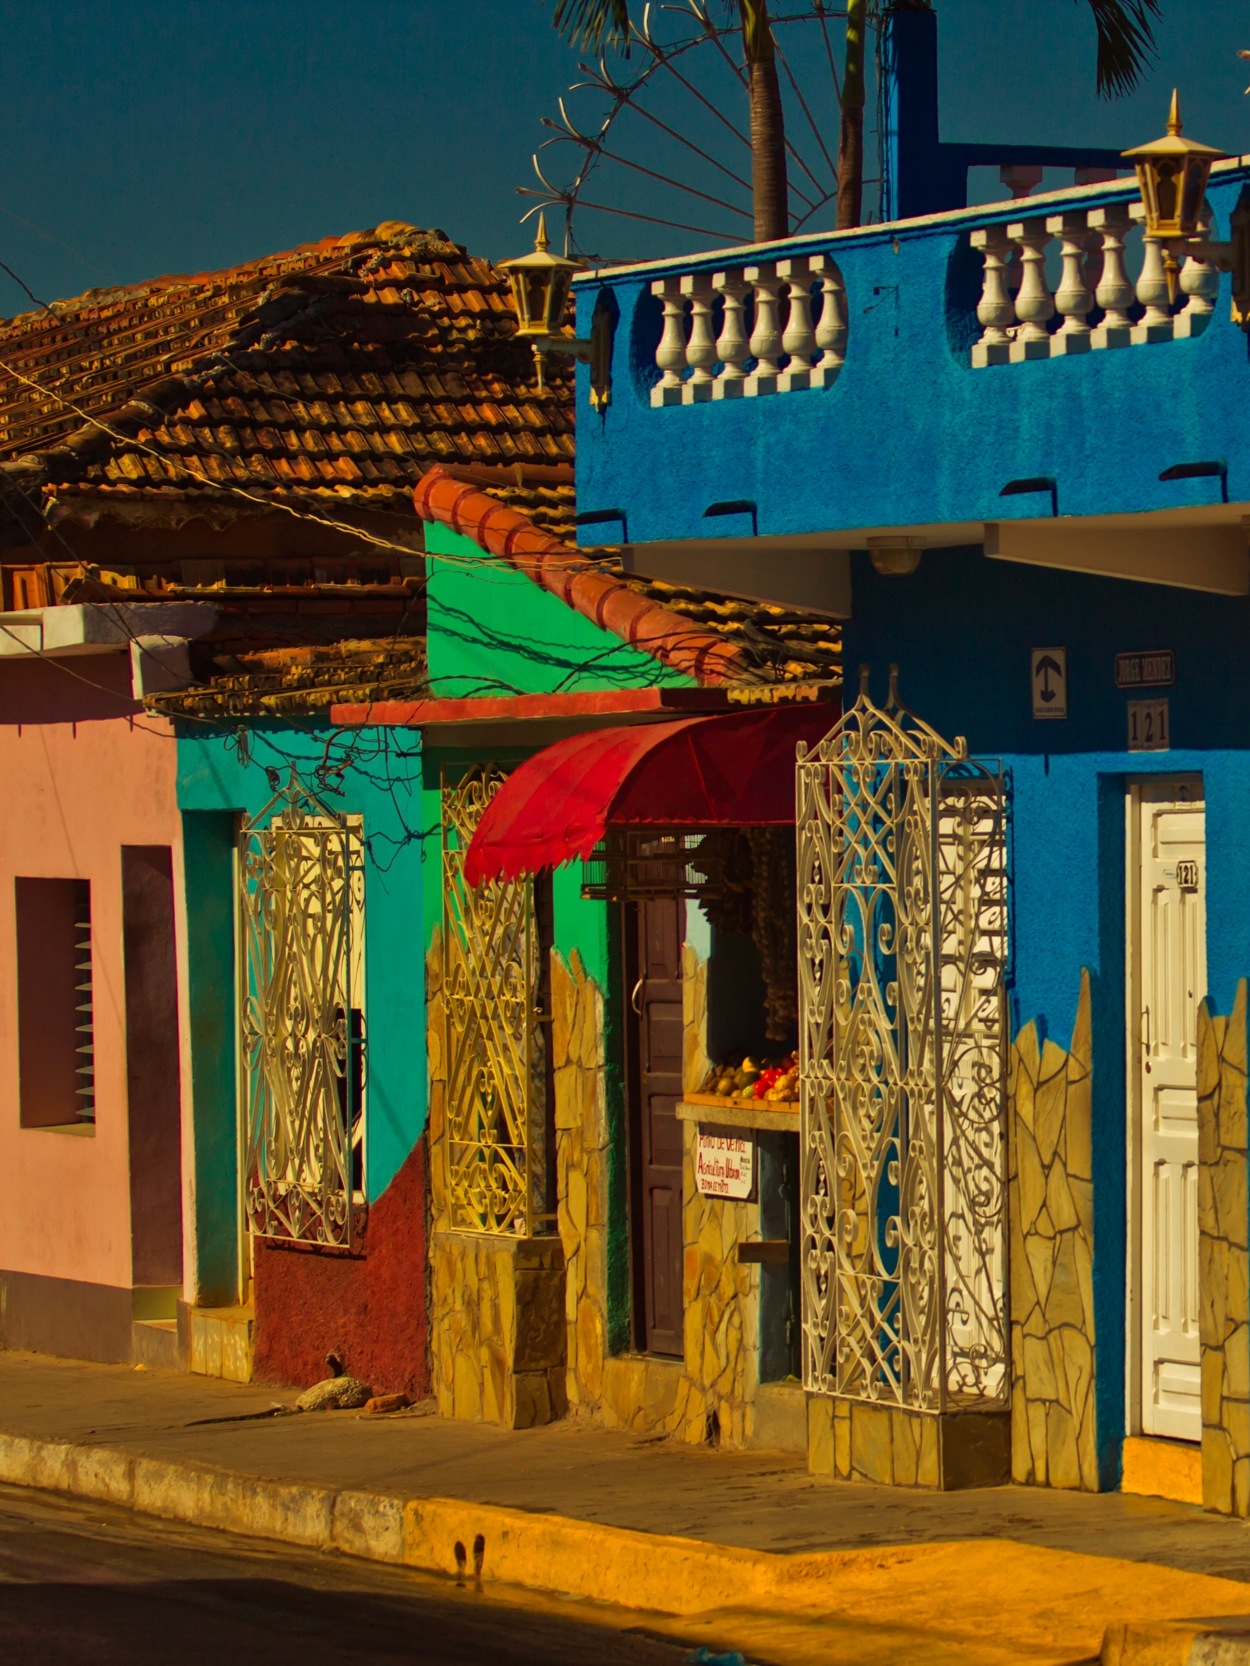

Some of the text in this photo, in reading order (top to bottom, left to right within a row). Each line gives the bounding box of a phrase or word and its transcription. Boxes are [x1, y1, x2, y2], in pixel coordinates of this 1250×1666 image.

[1118, 658, 1140, 682] JORGE
[1131, 709, 1167, 743] 121
[1178, 864, 1195, 885] 121
